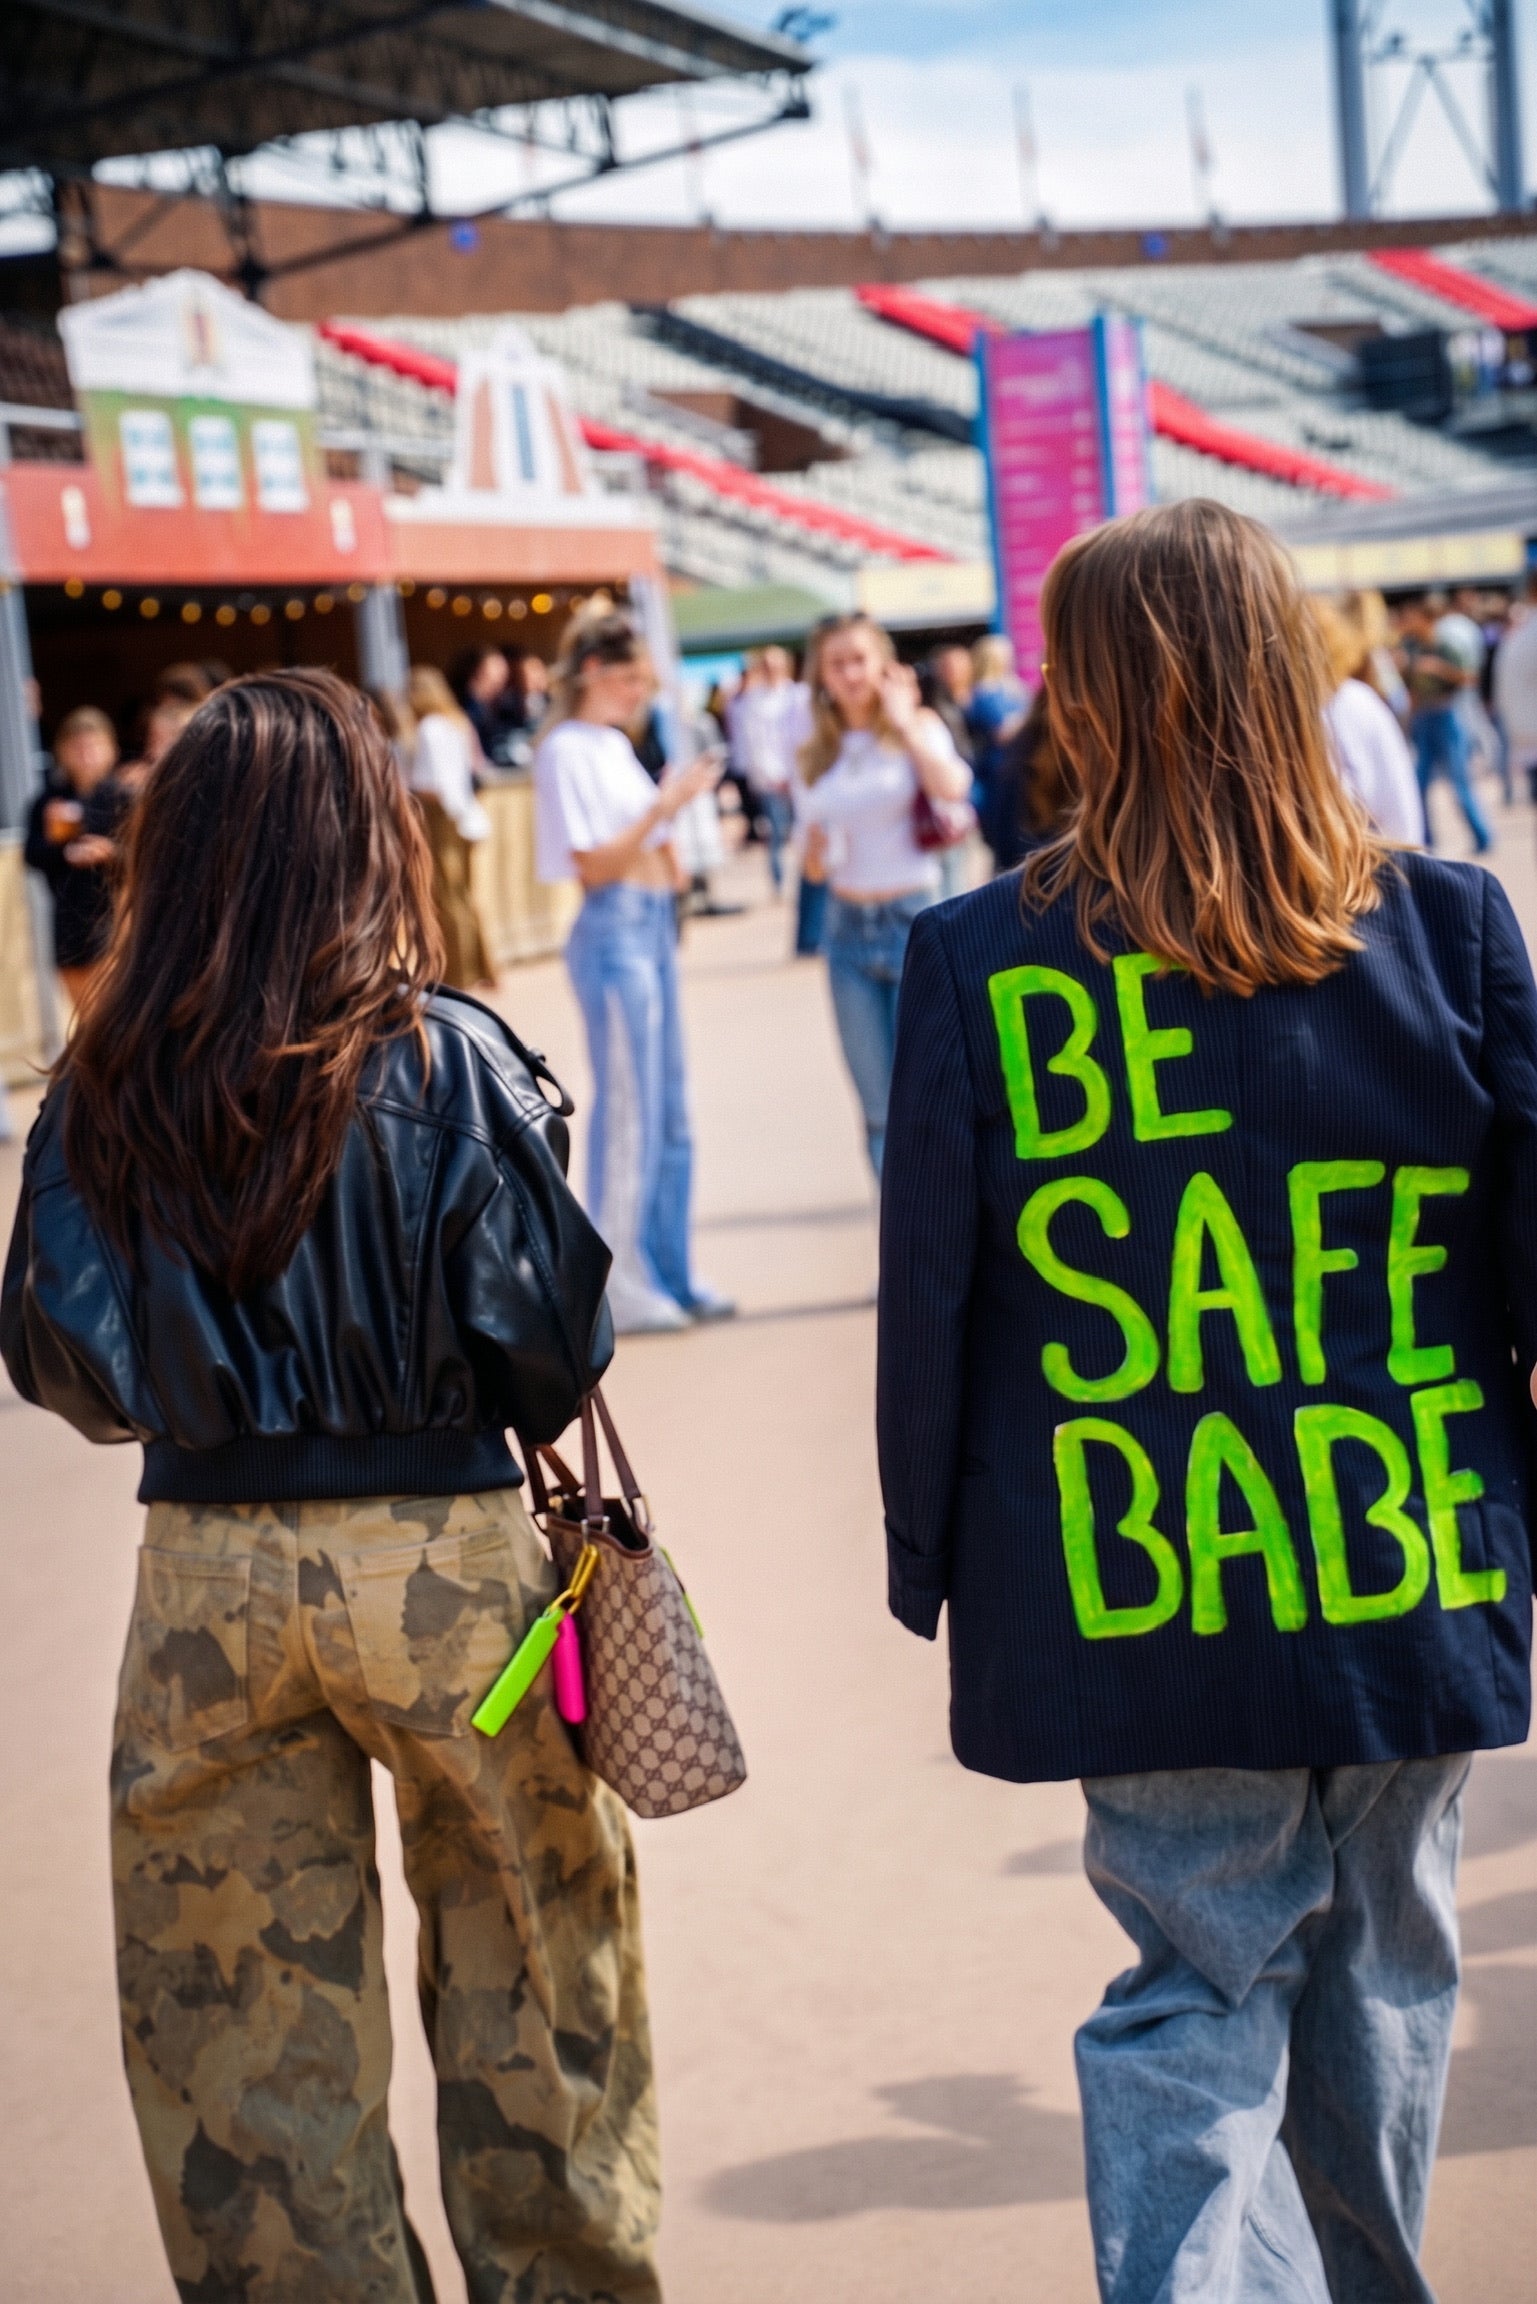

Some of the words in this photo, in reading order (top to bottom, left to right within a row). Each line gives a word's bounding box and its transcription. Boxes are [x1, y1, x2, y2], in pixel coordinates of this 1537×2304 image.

[987, 952, 1233, 1160] BE
[1016, 1161, 1469, 1402] SAFE
[1053, 1379, 1507, 1640] BABE
